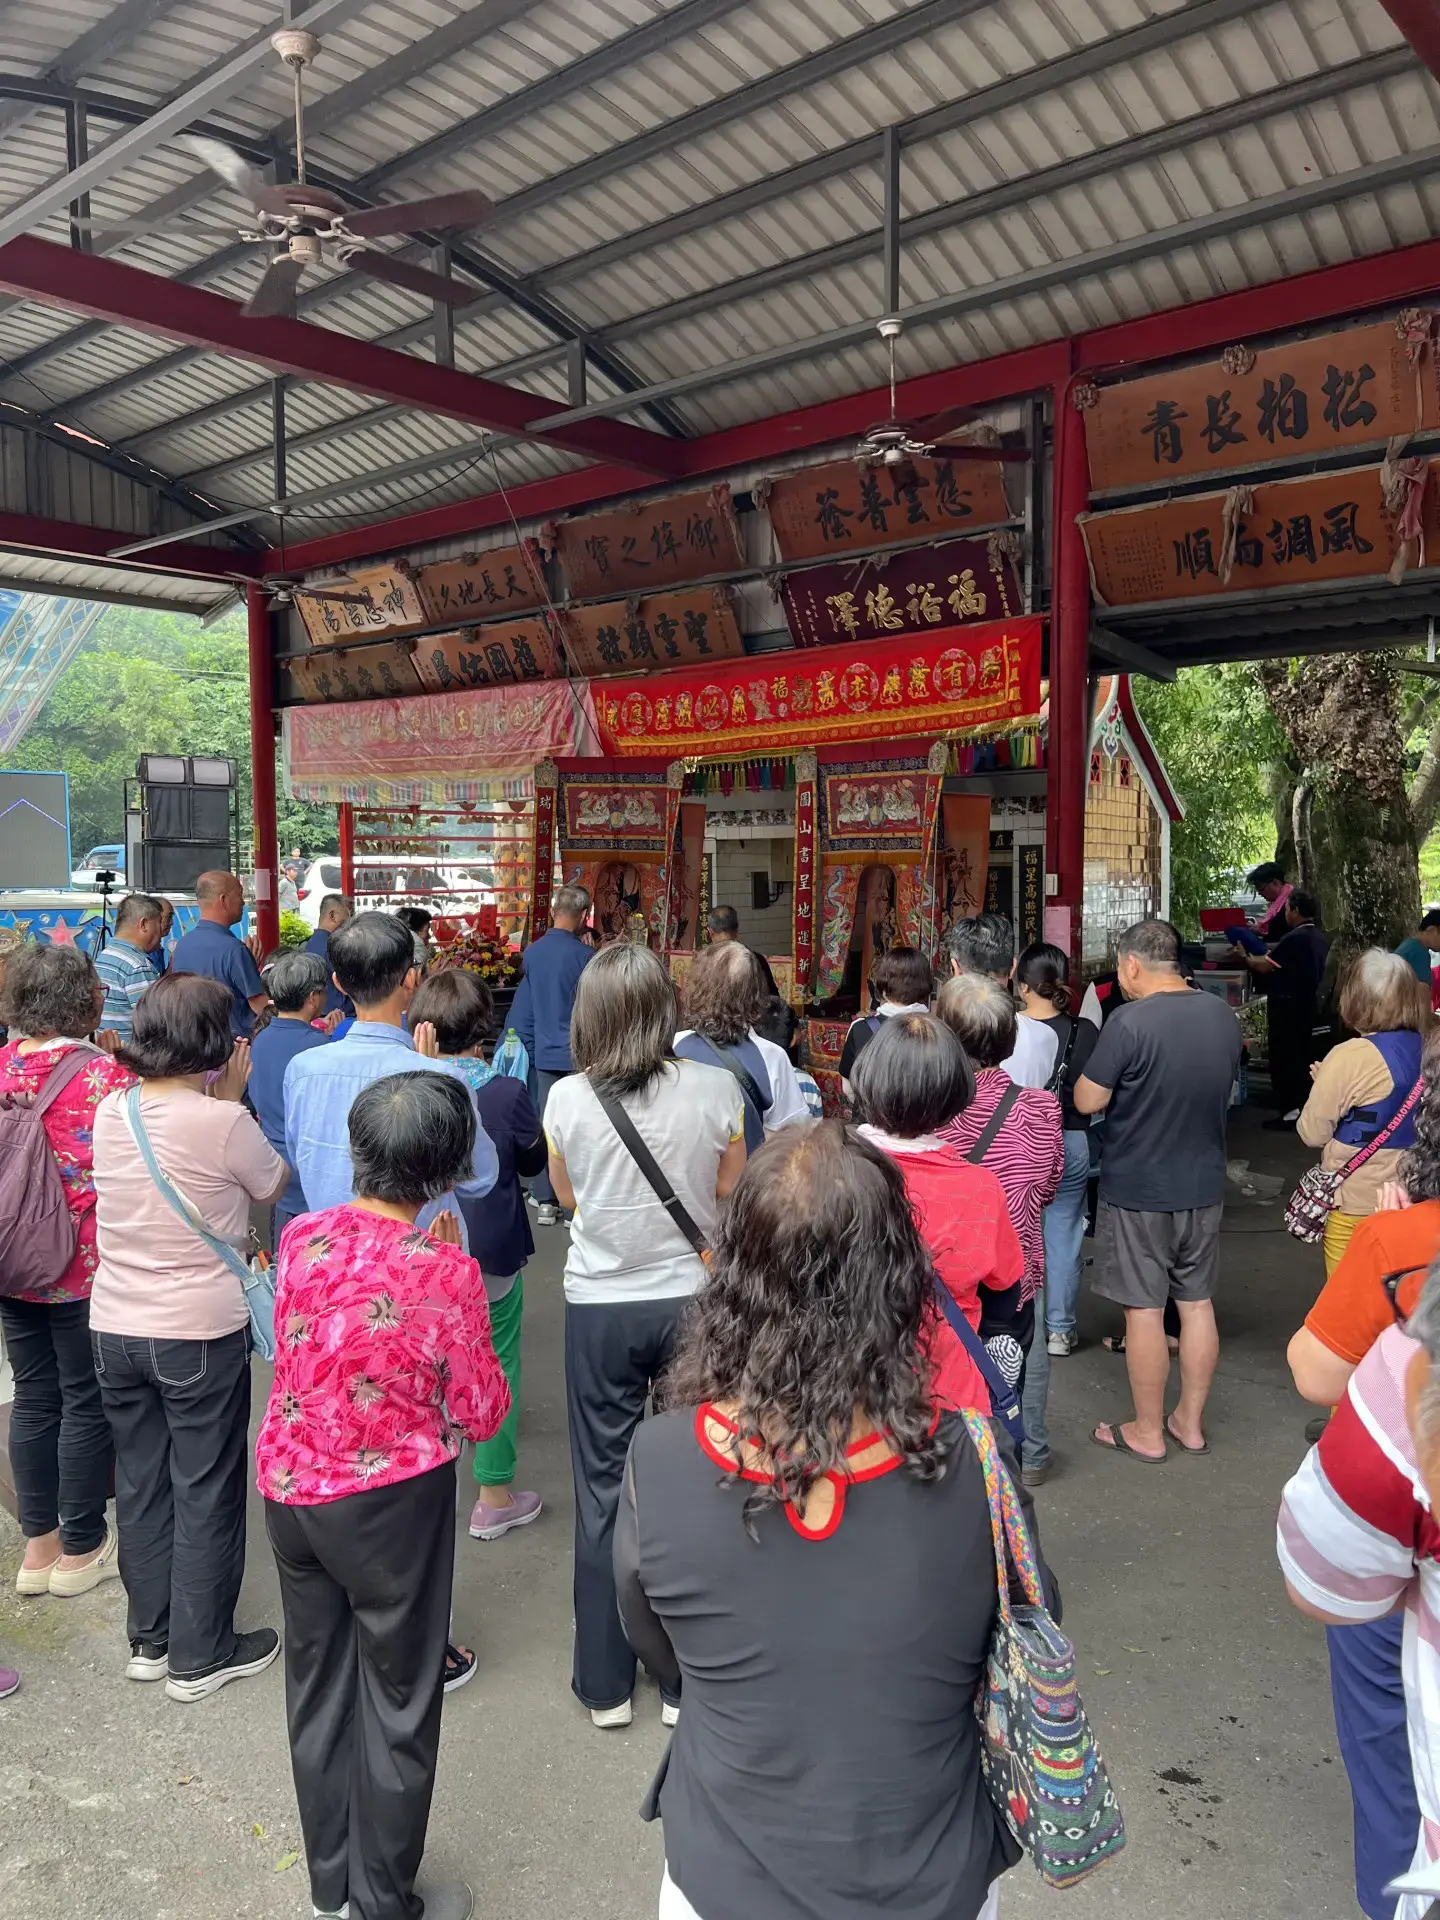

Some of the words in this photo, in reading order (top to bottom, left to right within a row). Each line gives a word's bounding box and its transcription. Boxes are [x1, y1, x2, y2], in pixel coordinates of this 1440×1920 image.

[1140, 364, 1377, 464] 松柏長青
[1172, 502, 1374, 580] 風調雨順
[440, 565, 528, 609] 天長地久
[825, 568, 987, 640] 福裕德澤
[431, 635, 544, 689] 護國佑民
